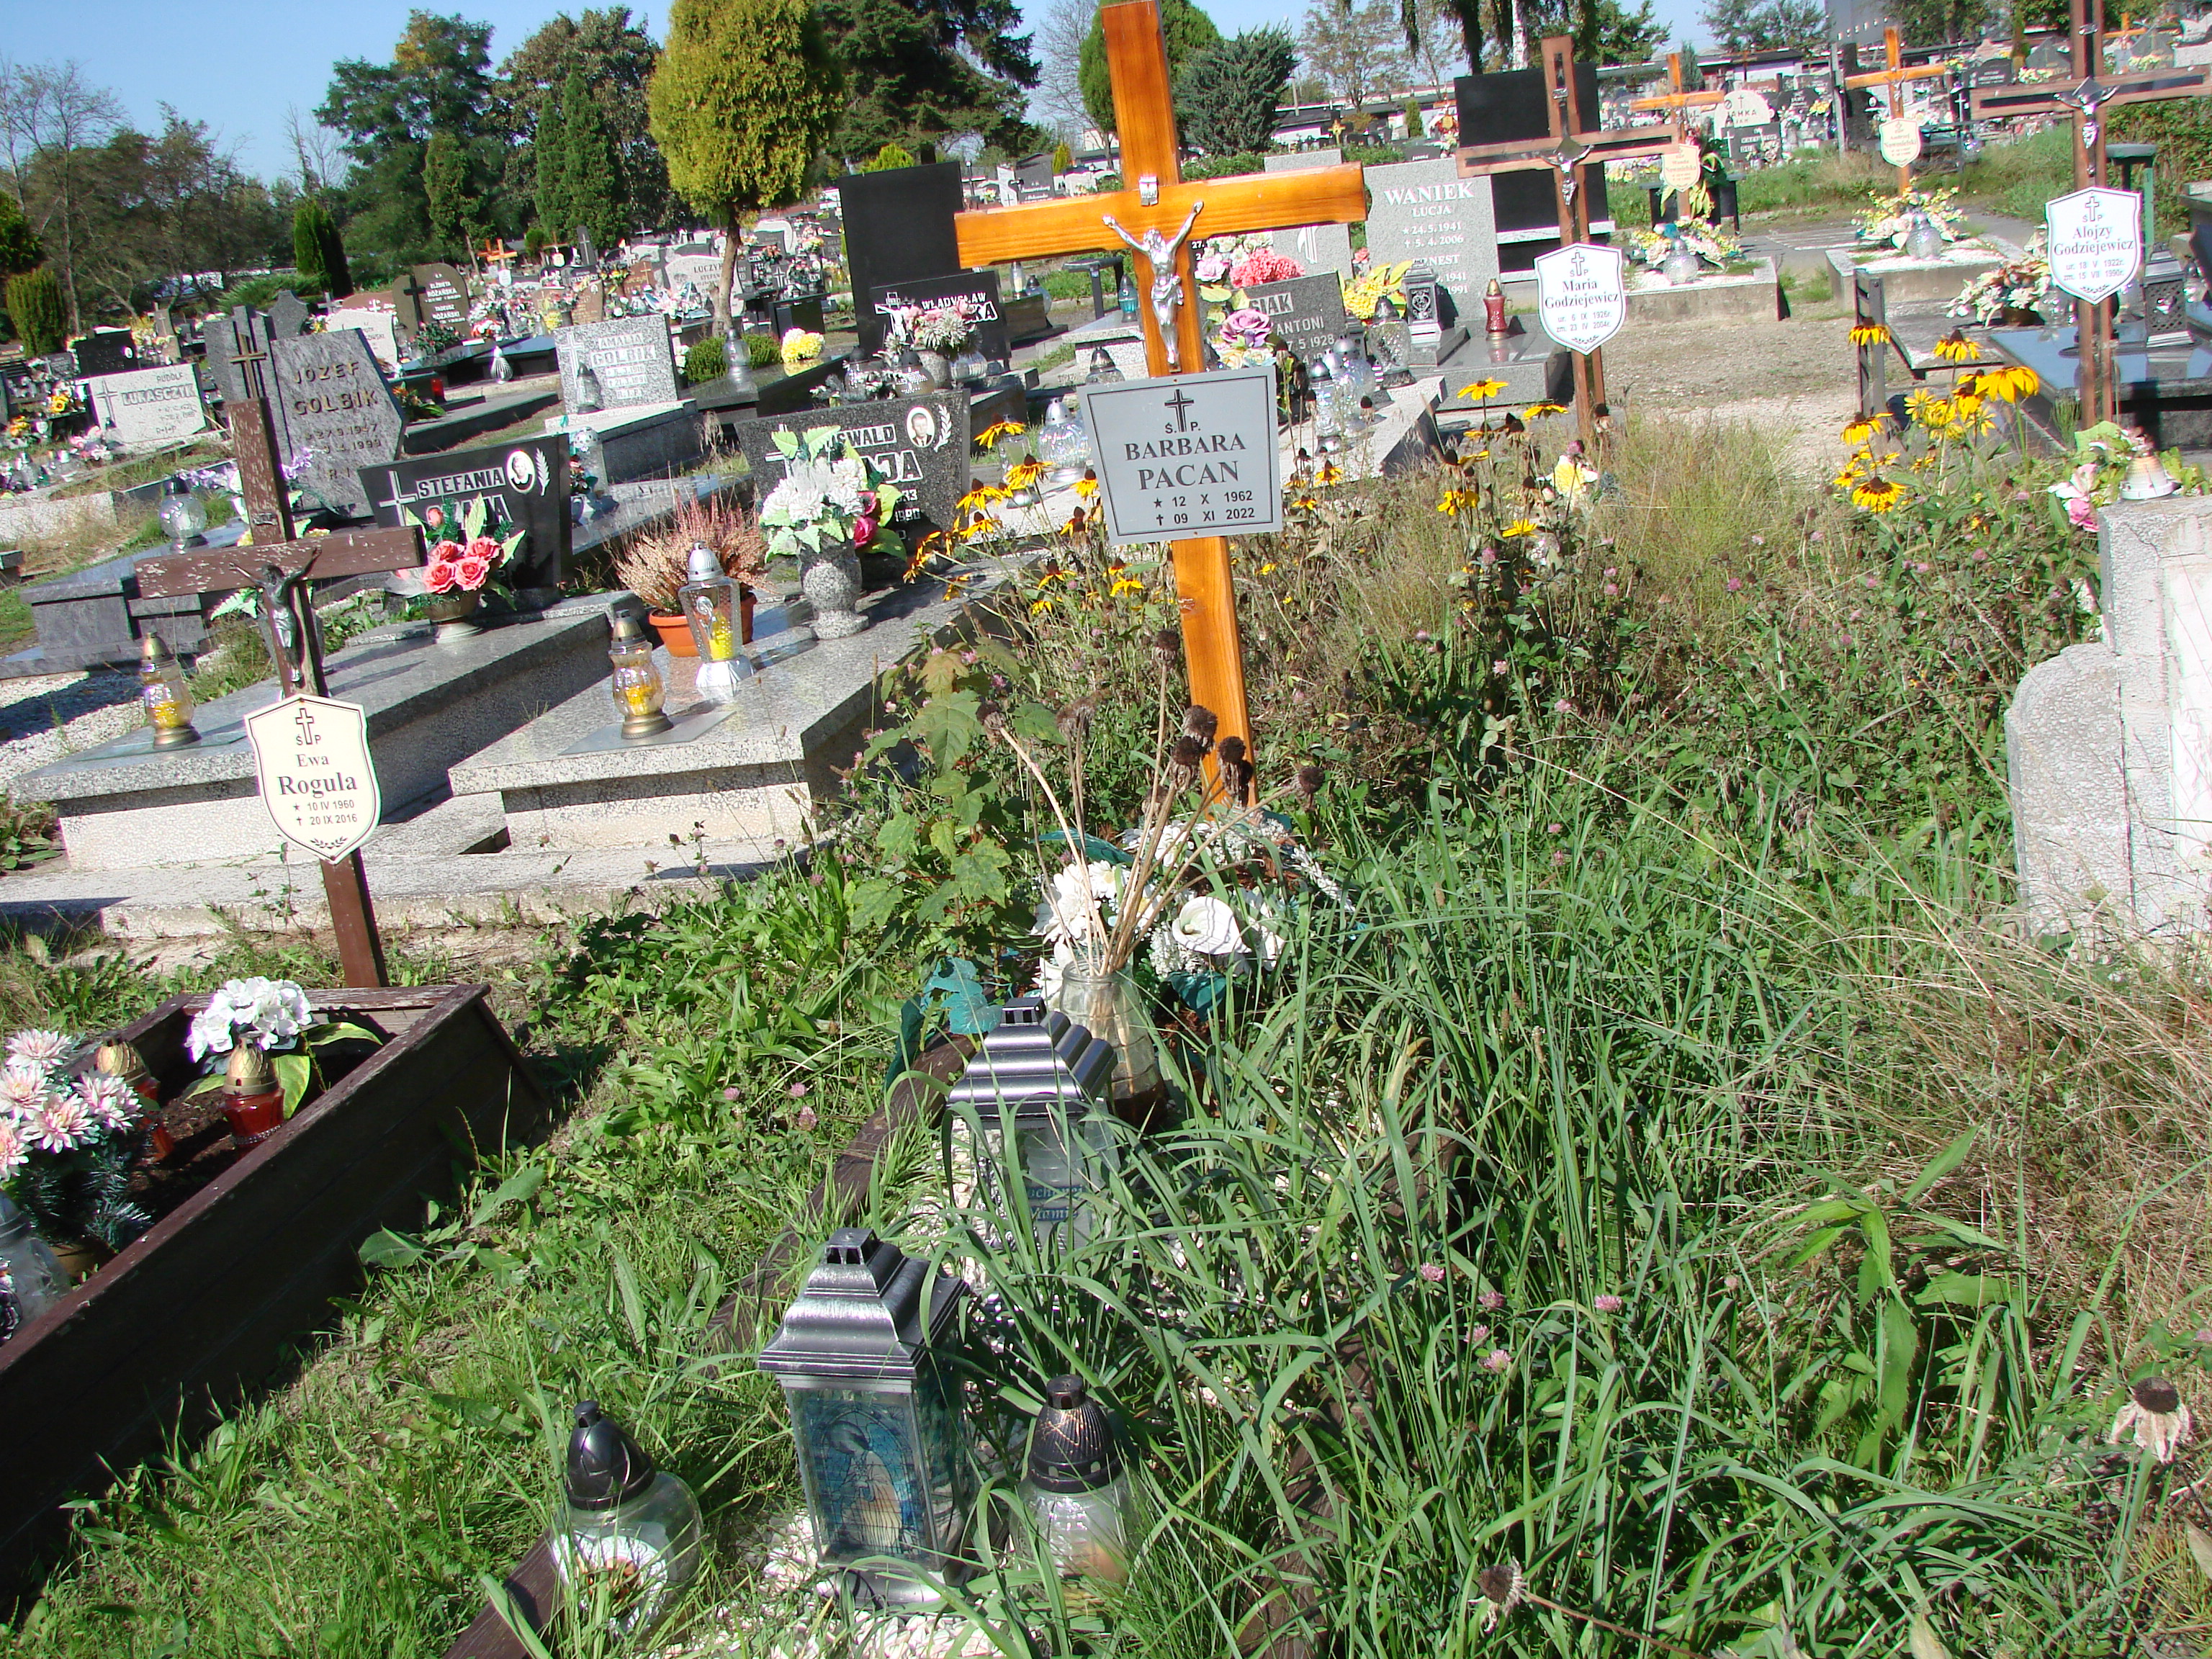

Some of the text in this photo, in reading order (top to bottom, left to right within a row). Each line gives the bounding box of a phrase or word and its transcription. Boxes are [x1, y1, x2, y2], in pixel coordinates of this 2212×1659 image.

[1384, 181, 1475, 206] WANIEK
[2072, 225, 2113, 240] Alojzy
[2054, 238, 2135, 256] Godziejewicz
[1562, 278, 1598, 293] Maria
[1250, 293, 1294, 315] SIAK
[1545, 290, 1619, 310] Godziejewicz
[1276, 315, 1325, 336] ANTONI
[601, 333, 644, 349] AMALIA
[592, 346, 656, 366] GOLBIK
[295, 361, 359, 385] JÓZEF
[294, 387, 379, 415] GOLBIK
[1164, 421, 1201, 434] Ś. P.
[1124, 433, 1246, 461] BARBARA
[418, 469, 505, 497] STEFANIA
[1138, 461, 1239, 491] PACAN
[1172, 490, 1254, 507] 12 X 1962
[1174, 507, 1255, 524] 09 XI 2022
[296, 734, 322, 746] Ś P
[296, 753, 330, 768] Ewa
[278, 772, 358, 799] Rogula
[308, 799, 355, 811] 10 IV 1960
[310, 814, 358, 826] 20 IX 2016
